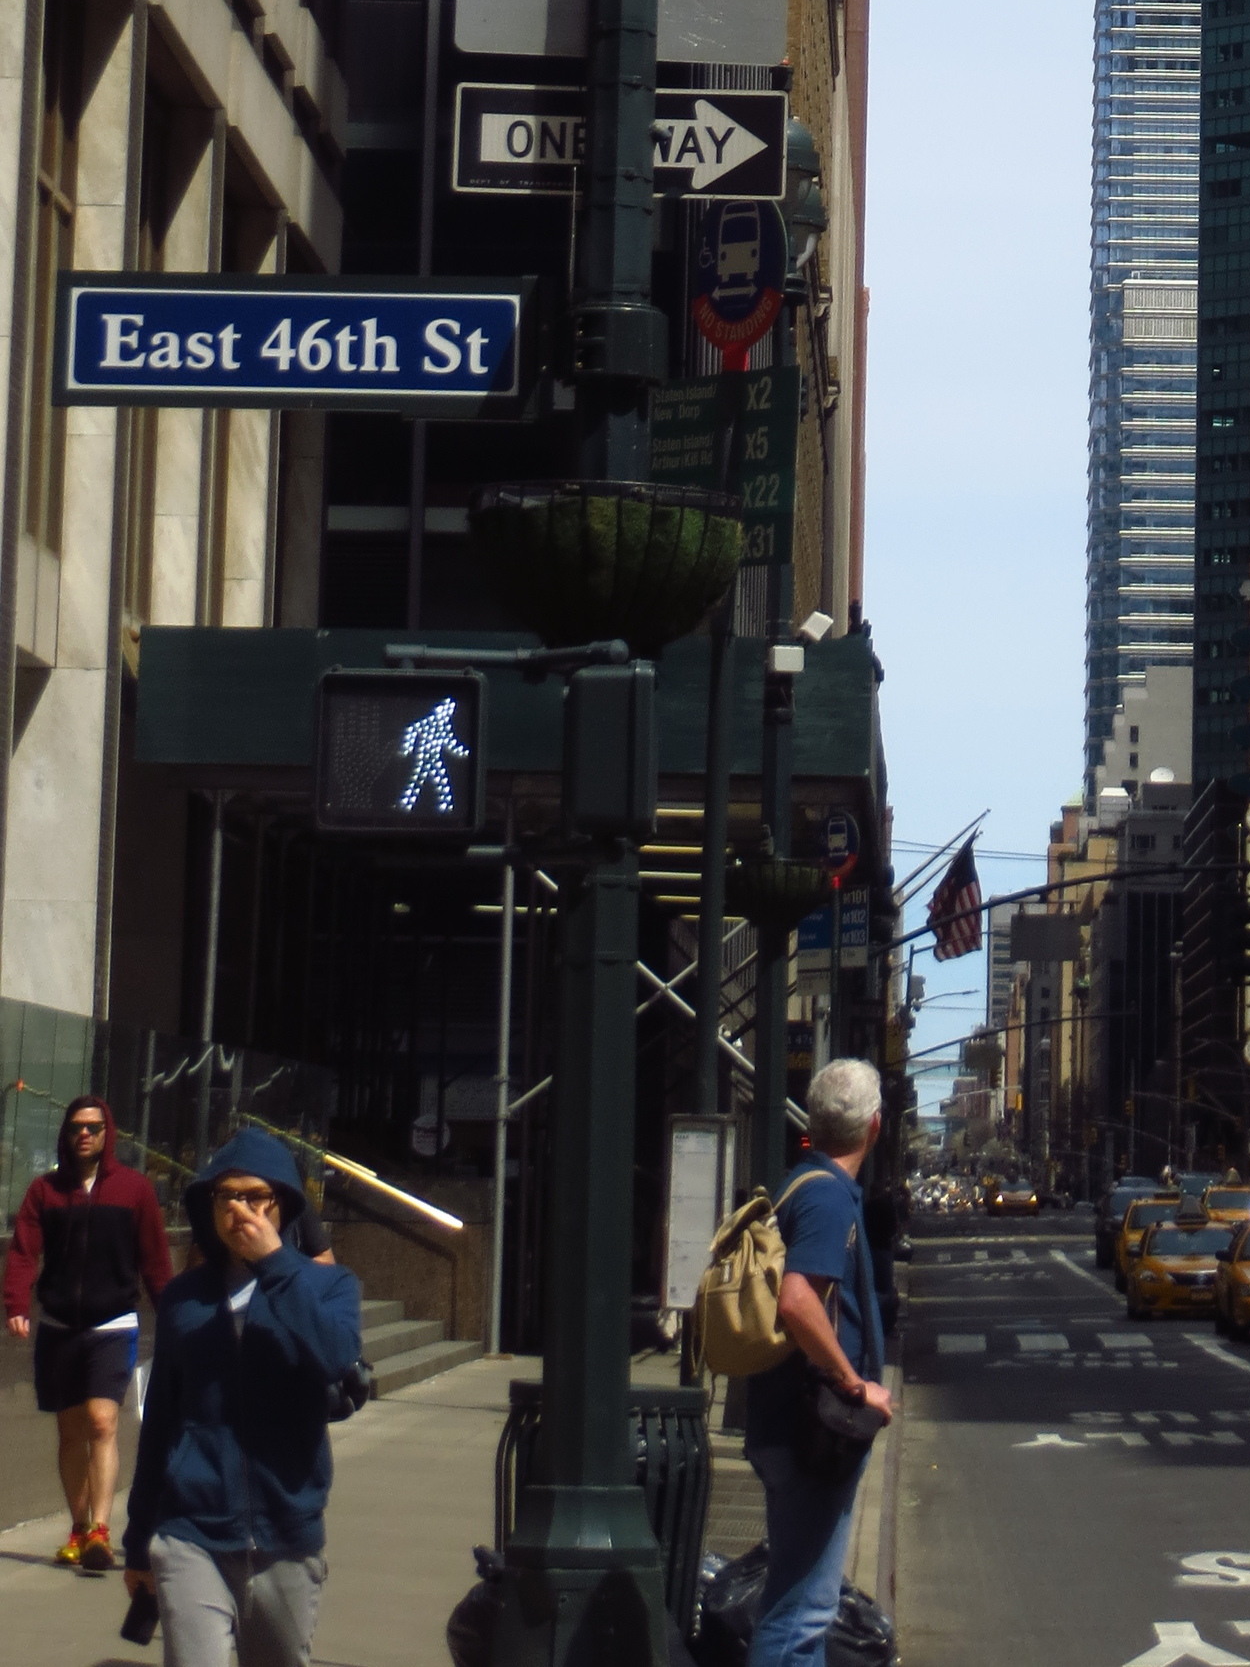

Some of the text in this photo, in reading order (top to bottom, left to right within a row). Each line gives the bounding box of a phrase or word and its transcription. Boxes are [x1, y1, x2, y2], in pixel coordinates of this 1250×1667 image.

[700, 296, 773, 342] NO STANDING
[100, 312, 490, 375] East 46th St
[654, 389, 684, 404] Staten
[653, 403, 700, 421] New Dorp
[652, 437, 682, 453] Staten
[843, 889, 867, 905] M101
[842, 909, 867, 925] M102
